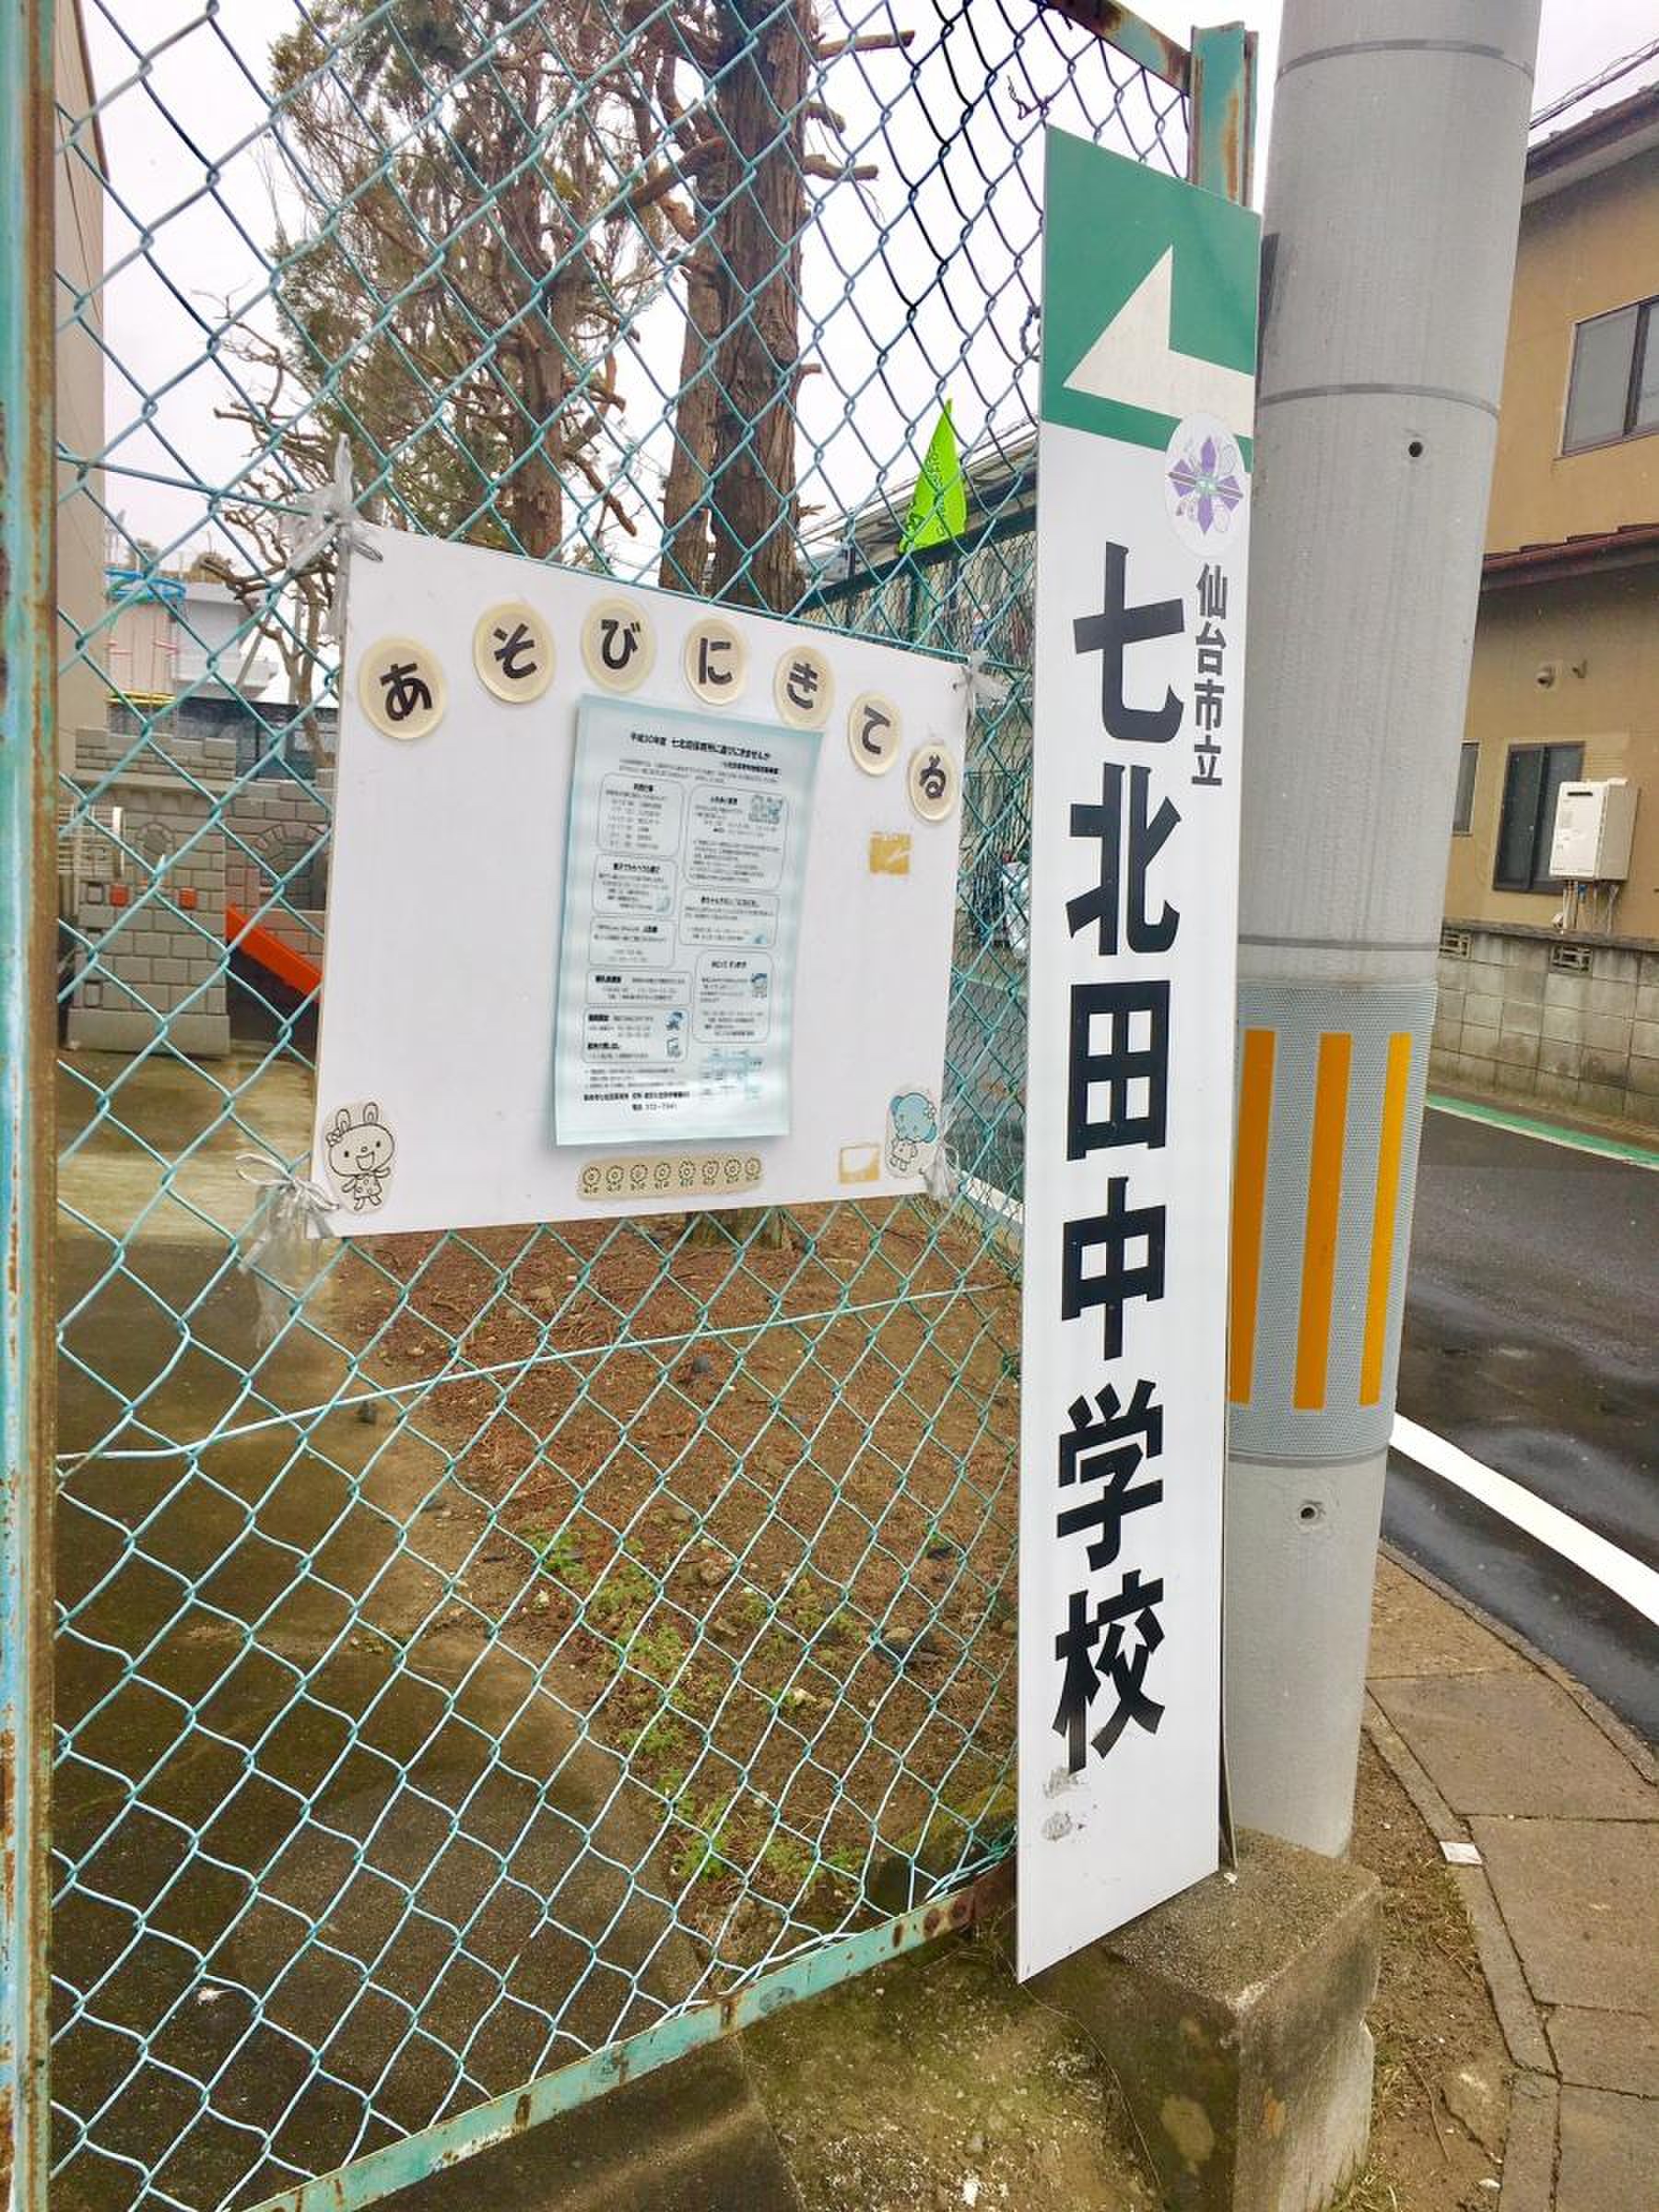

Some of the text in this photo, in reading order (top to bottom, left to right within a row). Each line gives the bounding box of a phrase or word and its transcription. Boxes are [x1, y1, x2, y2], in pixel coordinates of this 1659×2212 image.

[1191, 562, 1229, 787] 仙台市立
[1051, 541, 1185, 1775] 七北田中学校
